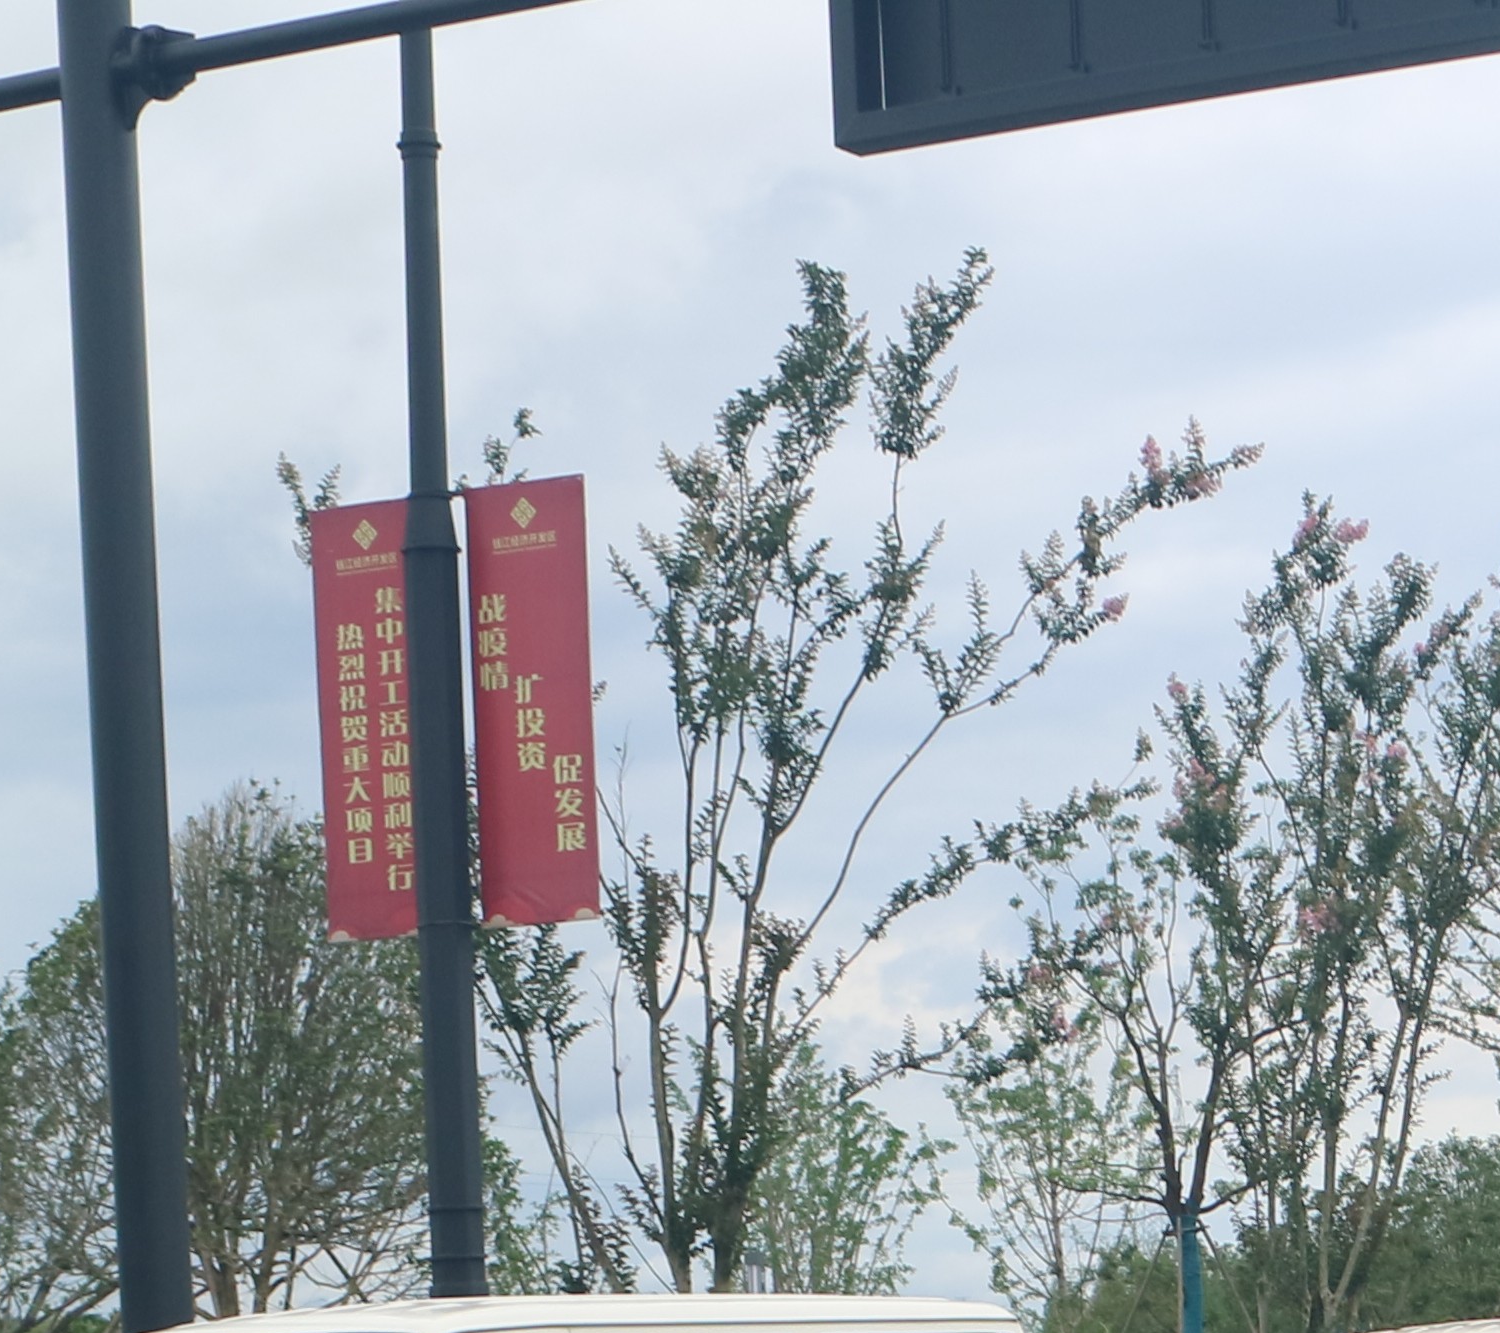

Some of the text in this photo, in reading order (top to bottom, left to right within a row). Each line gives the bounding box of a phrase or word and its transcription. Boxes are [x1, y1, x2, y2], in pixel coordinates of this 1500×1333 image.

[478, 594, 509, 691] 战疫情
[337, 623, 374, 865] 热烈祝贺重大项目
[375, 586, 414, 892] 集中开工活动顺利举行
[514, 674, 547, 772] 扩投资
[553, 754, 587, 853] 促发展
